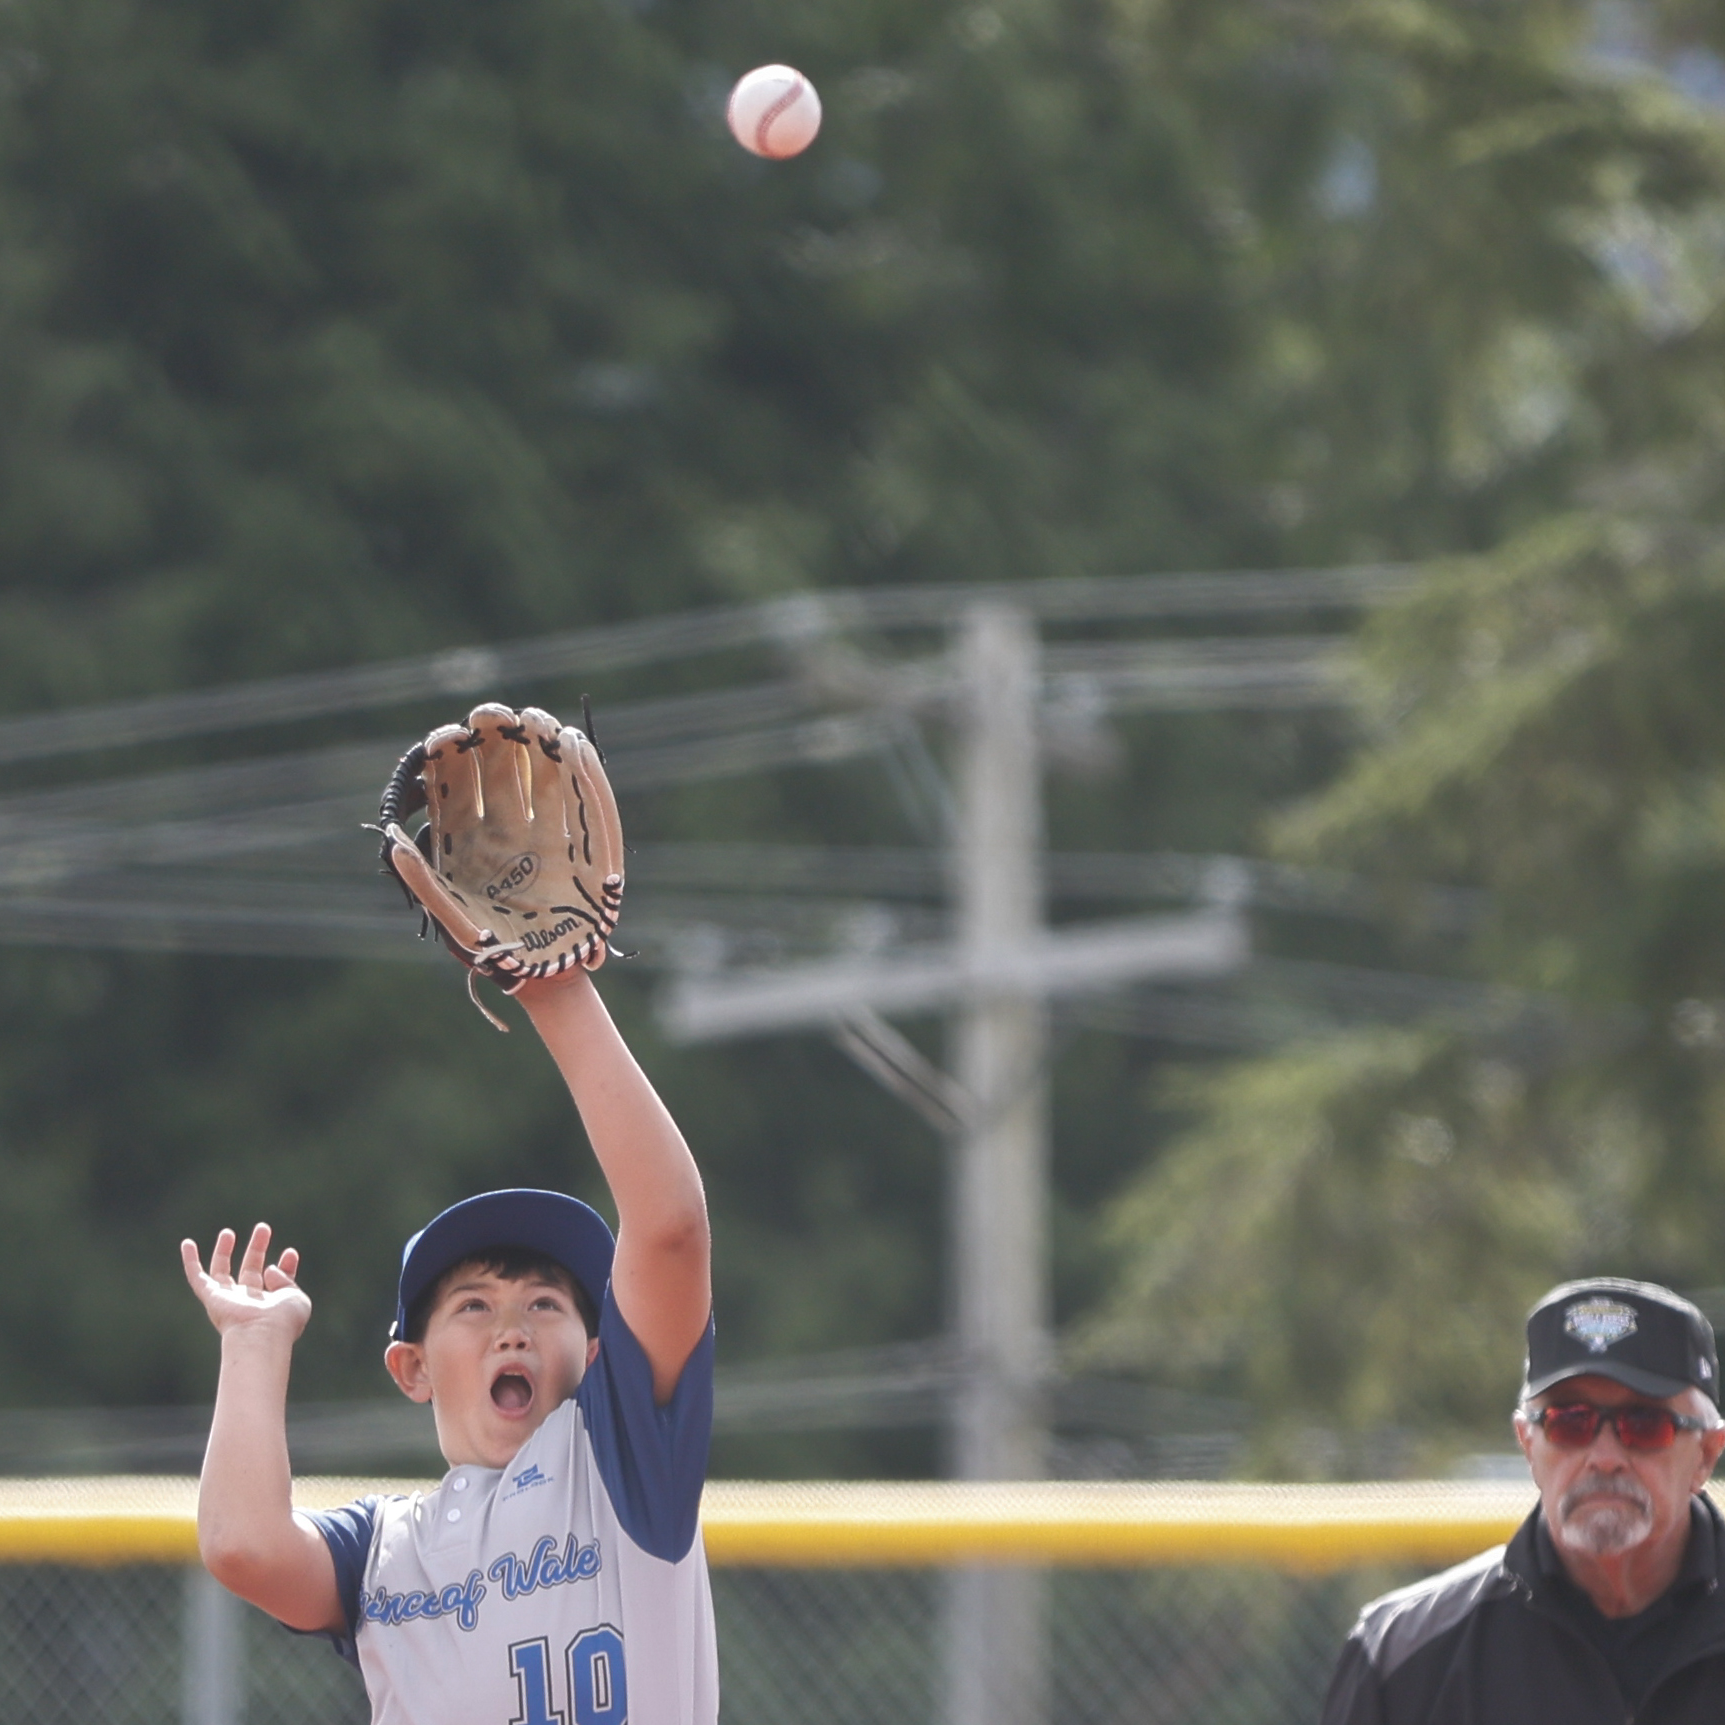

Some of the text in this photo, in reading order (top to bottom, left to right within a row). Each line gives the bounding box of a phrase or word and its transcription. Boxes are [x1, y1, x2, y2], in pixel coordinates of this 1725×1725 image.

[486, 856, 534, 900] A450
[520, 917, 580, 952] Wilson
[361, 1533, 601, 1631] ince of Wale
